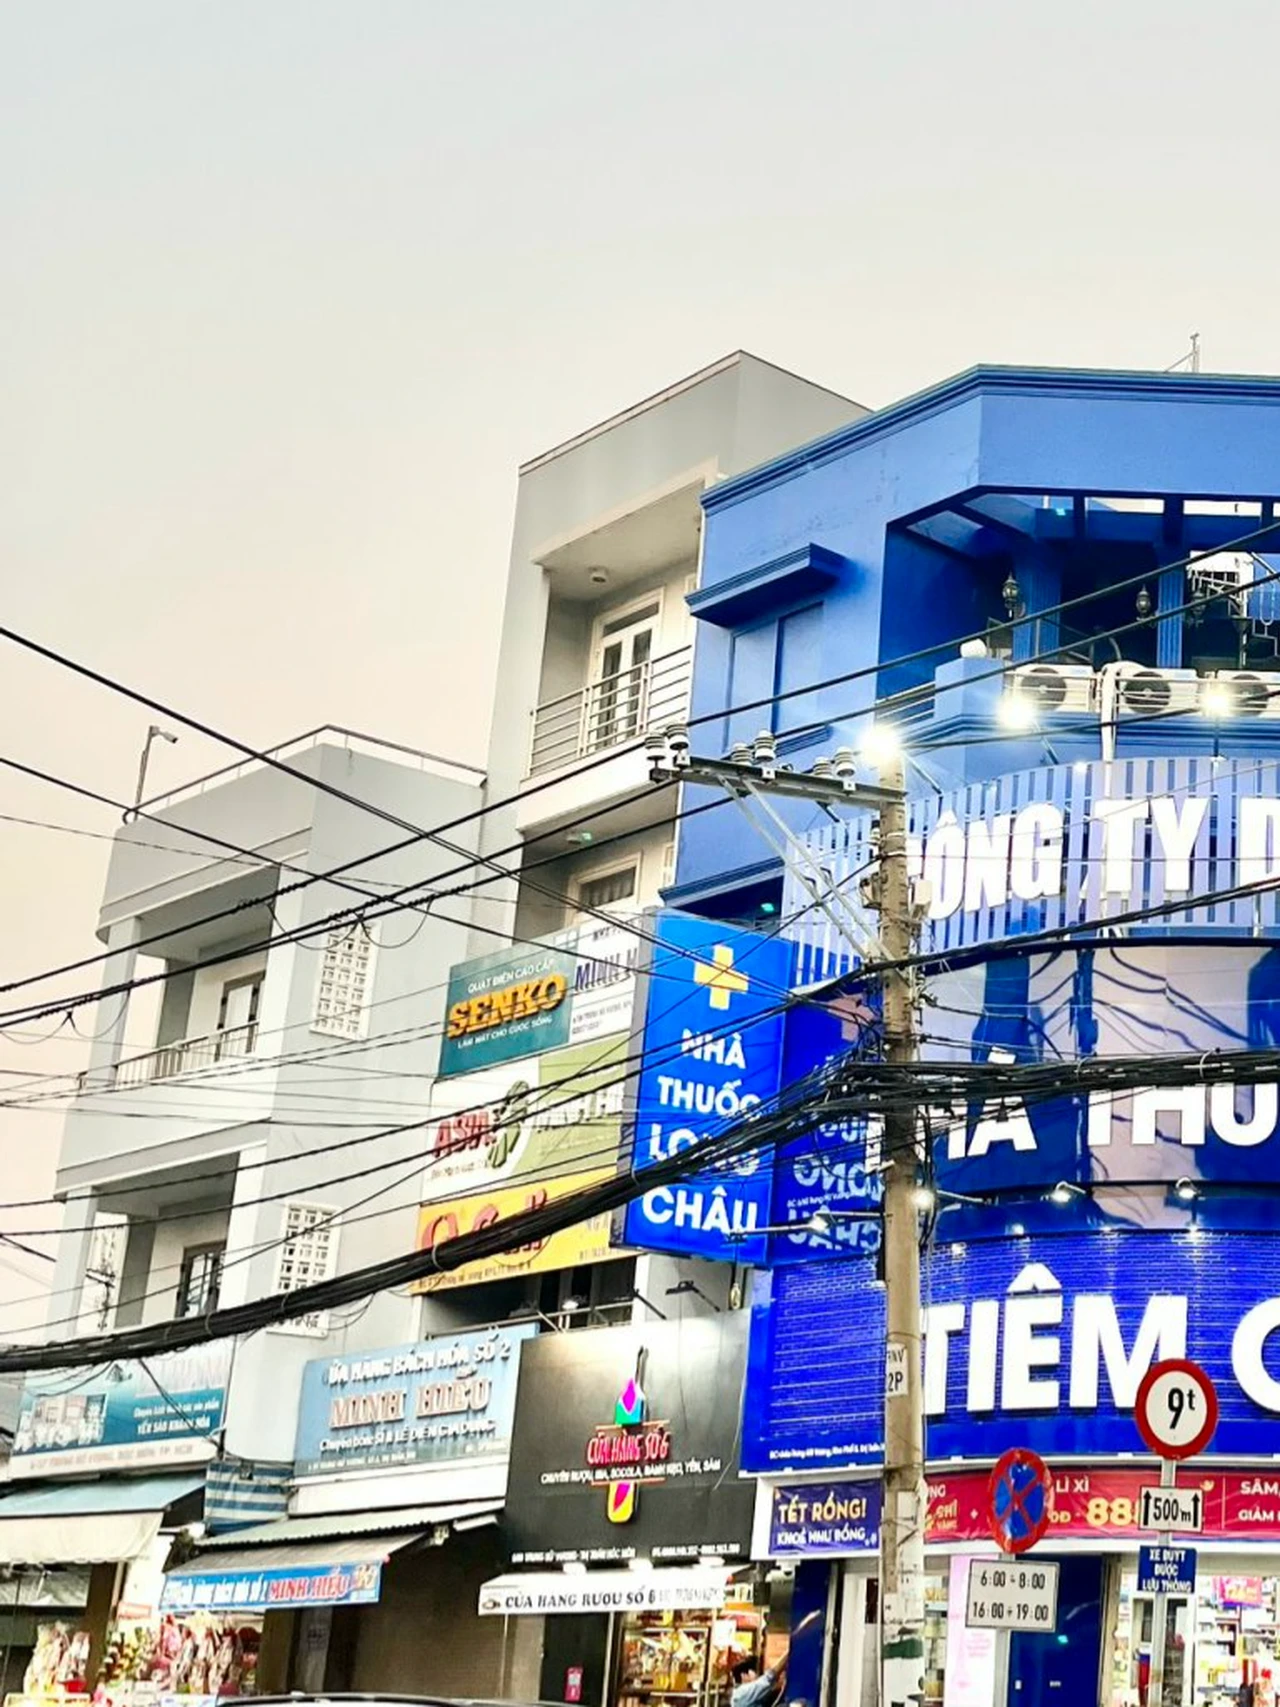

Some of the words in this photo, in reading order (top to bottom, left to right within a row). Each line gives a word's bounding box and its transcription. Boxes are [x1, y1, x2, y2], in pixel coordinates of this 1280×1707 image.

[1105, 797, 1209, 892] TY
[448, 972, 567, 1038] SENKO
[682, 1028, 747, 1070] NHÀ
[642, 1186, 758, 1236] CHÂU
[920, 1263, 1188, 1415] TIÊM
[330, 1388, 406, 1429] MINH
[980, 1570, 1006, 1587] 6:00
[1018, 1572, 1046, 1590] 8:00
[973, 1601, 1004, 1619] 16:00
[1016, 1603, 1049, 1621] 19:00
